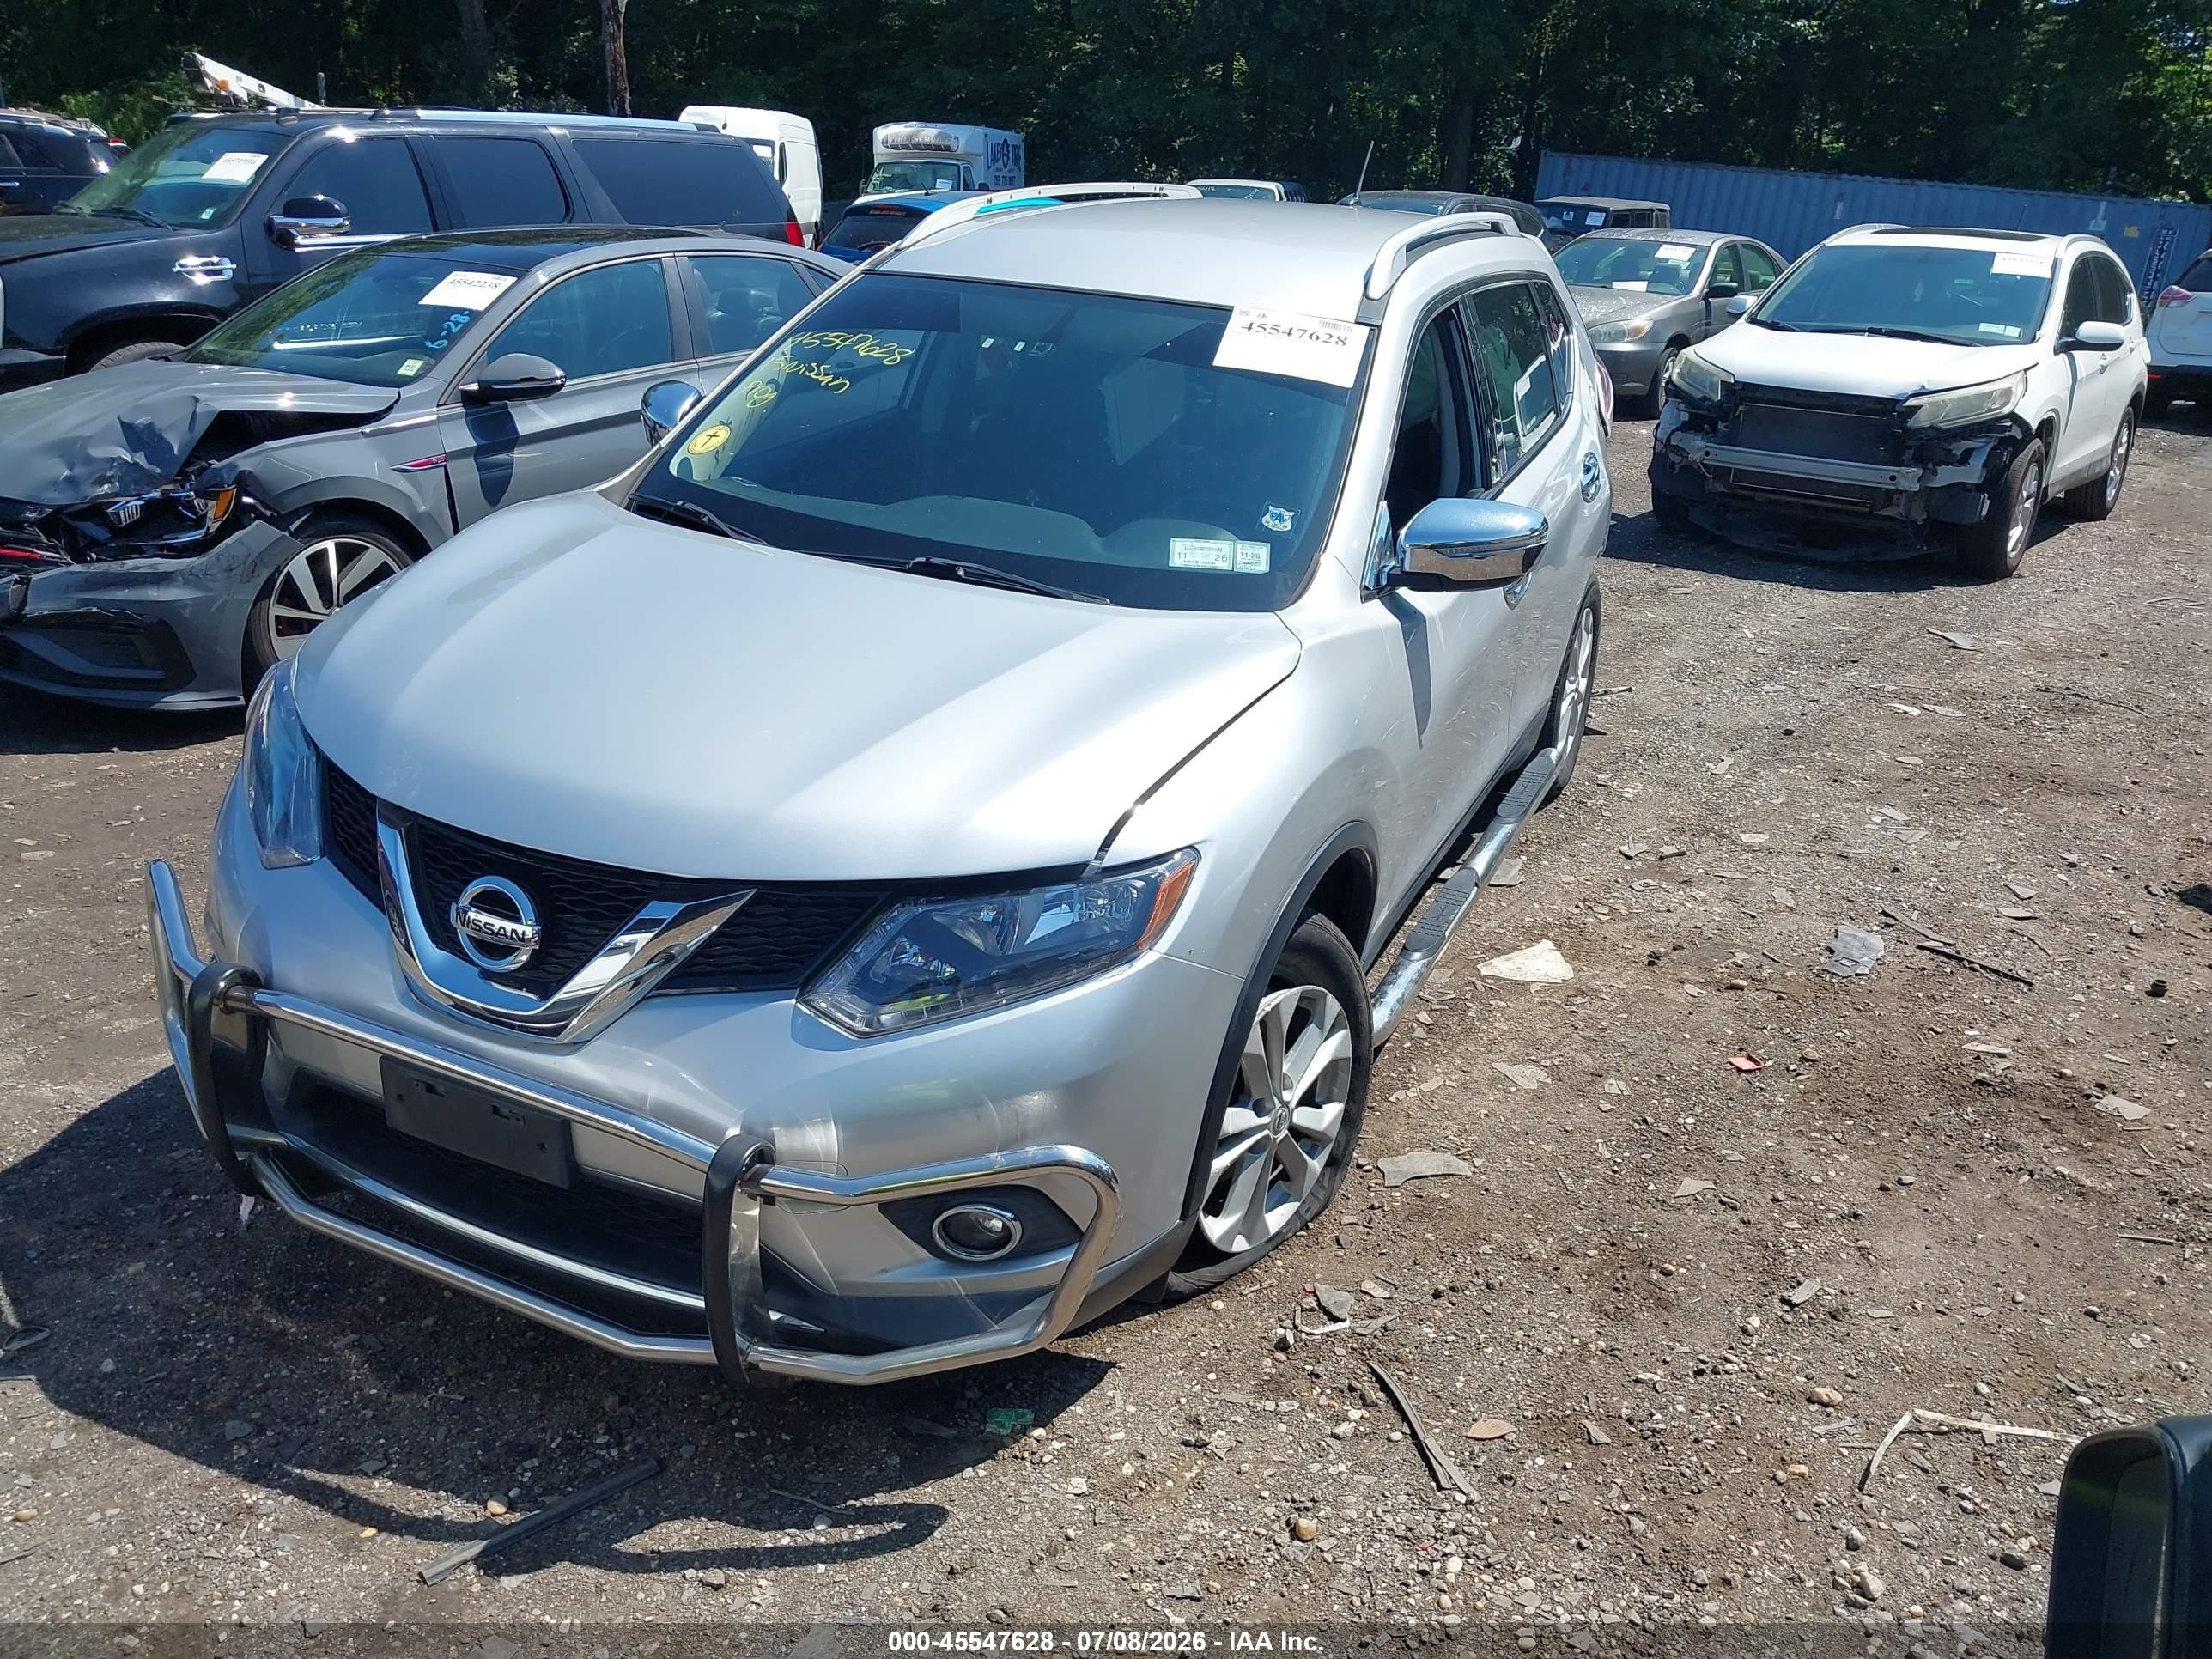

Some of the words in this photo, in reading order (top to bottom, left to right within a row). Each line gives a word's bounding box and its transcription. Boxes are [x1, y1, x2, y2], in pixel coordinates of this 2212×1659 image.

[1241, 321, 1348, 347] 45547628
[1214, 554, 1229, 562] 26
[455, 911, 526, 944] NISSAN
